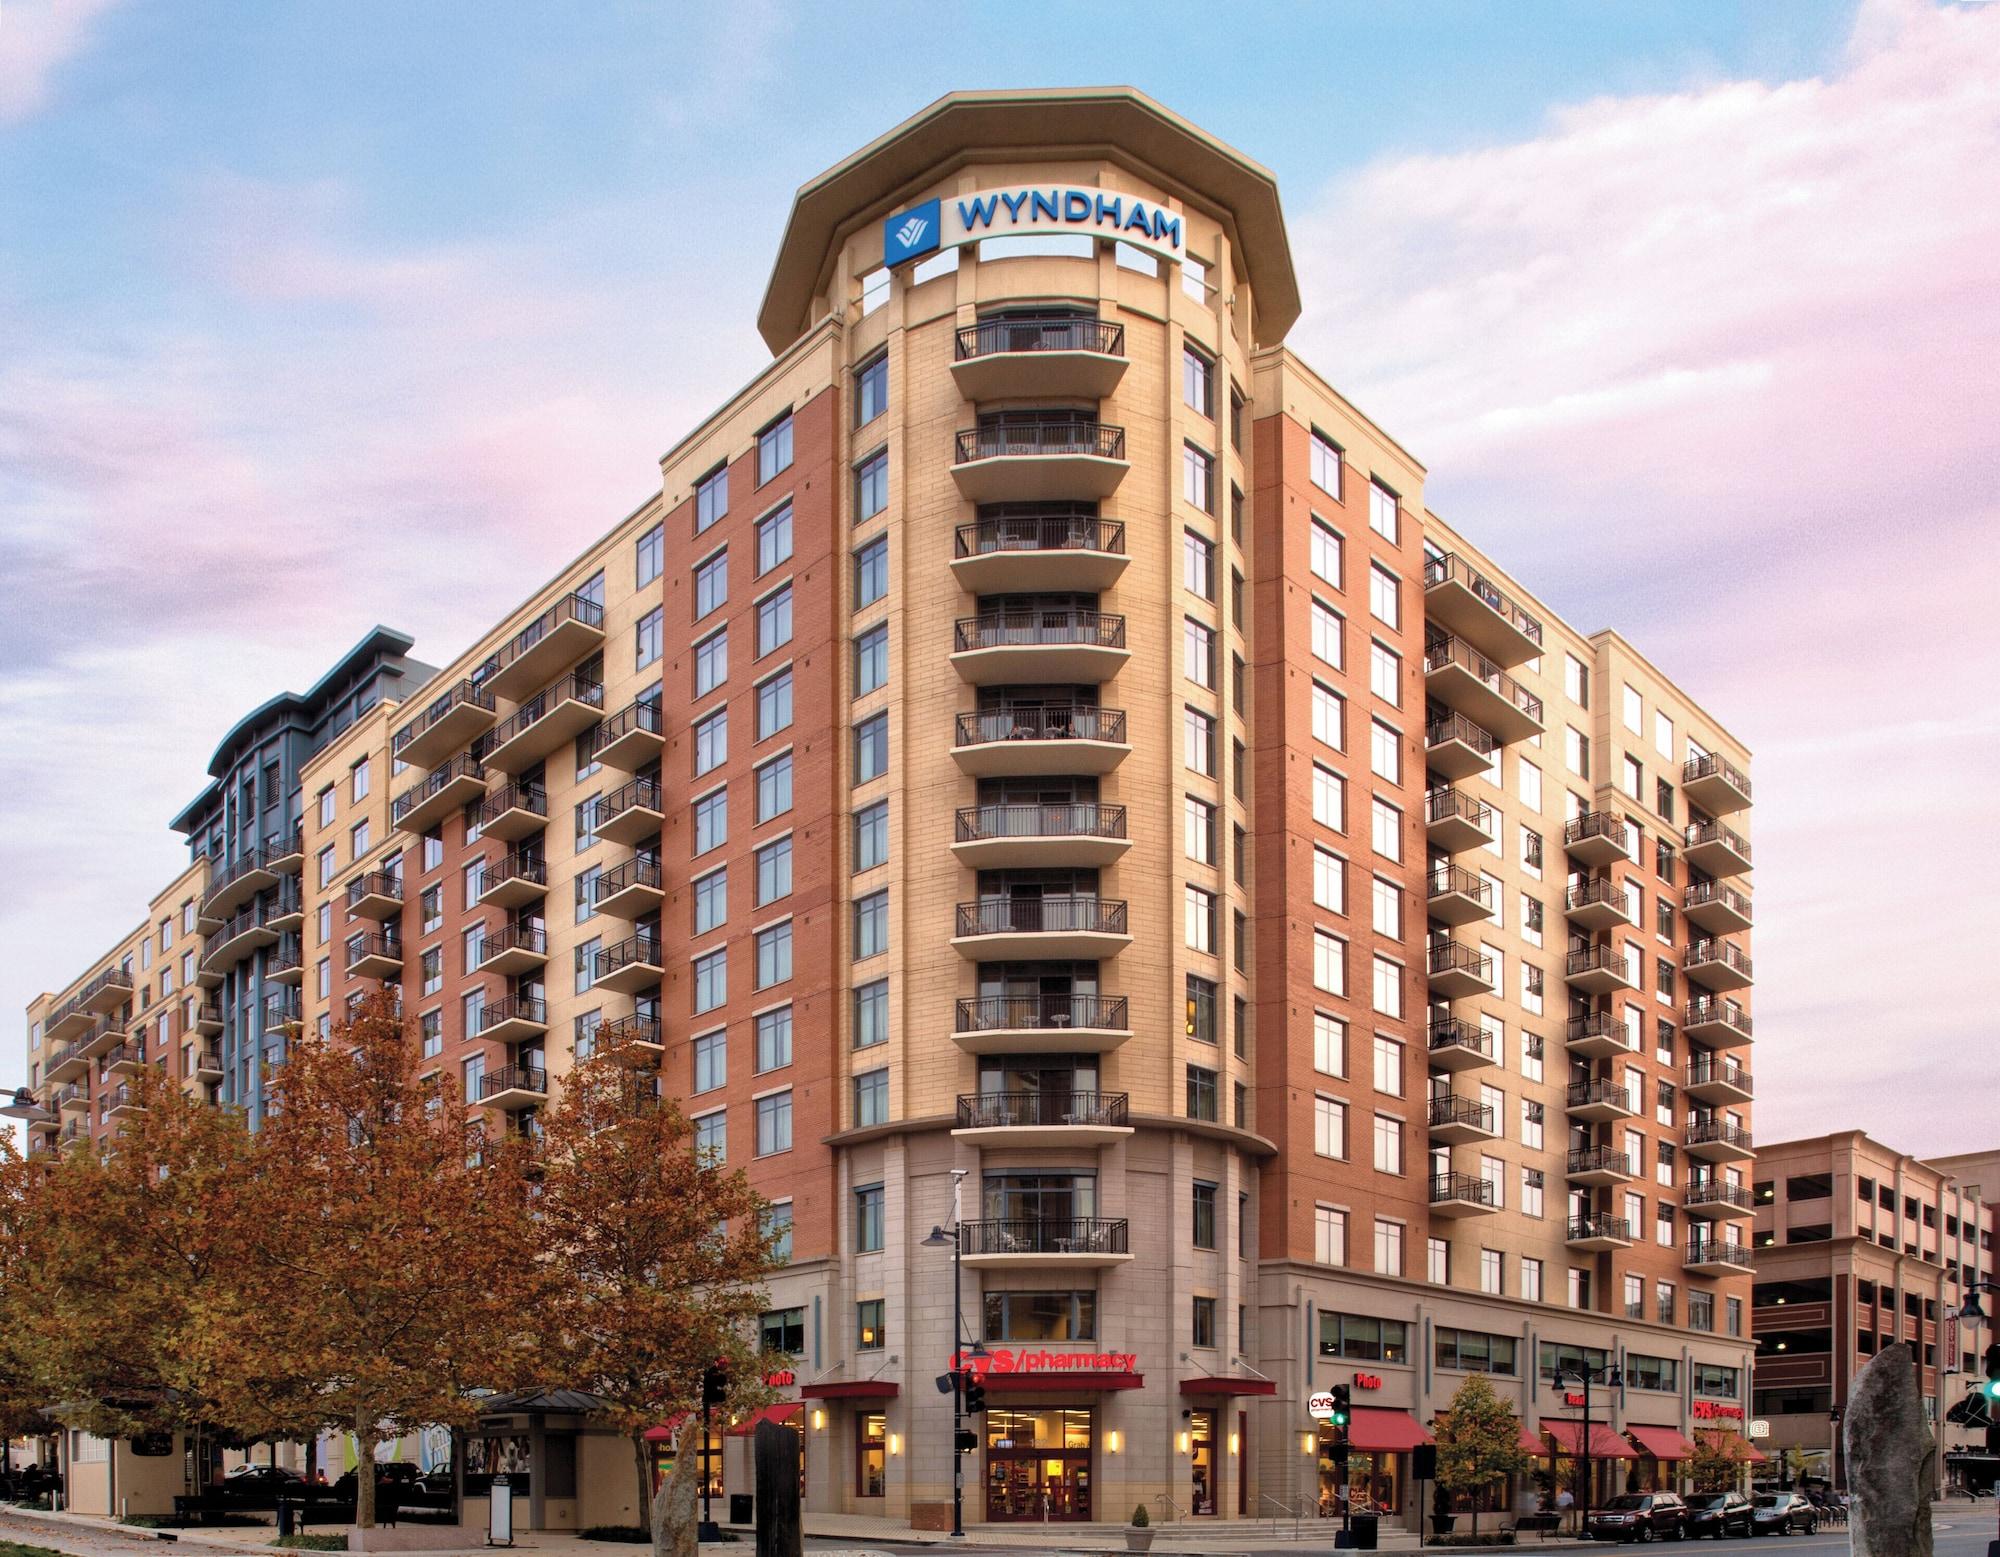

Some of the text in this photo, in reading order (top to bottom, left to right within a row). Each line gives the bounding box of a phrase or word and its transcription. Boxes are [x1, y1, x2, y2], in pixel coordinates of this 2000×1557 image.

[957, 190, 1181, 248] WYNDHAM
[1357, 1373, 1382, 1389] Photo
[1310, 1397, 1333, 1408] CVS
